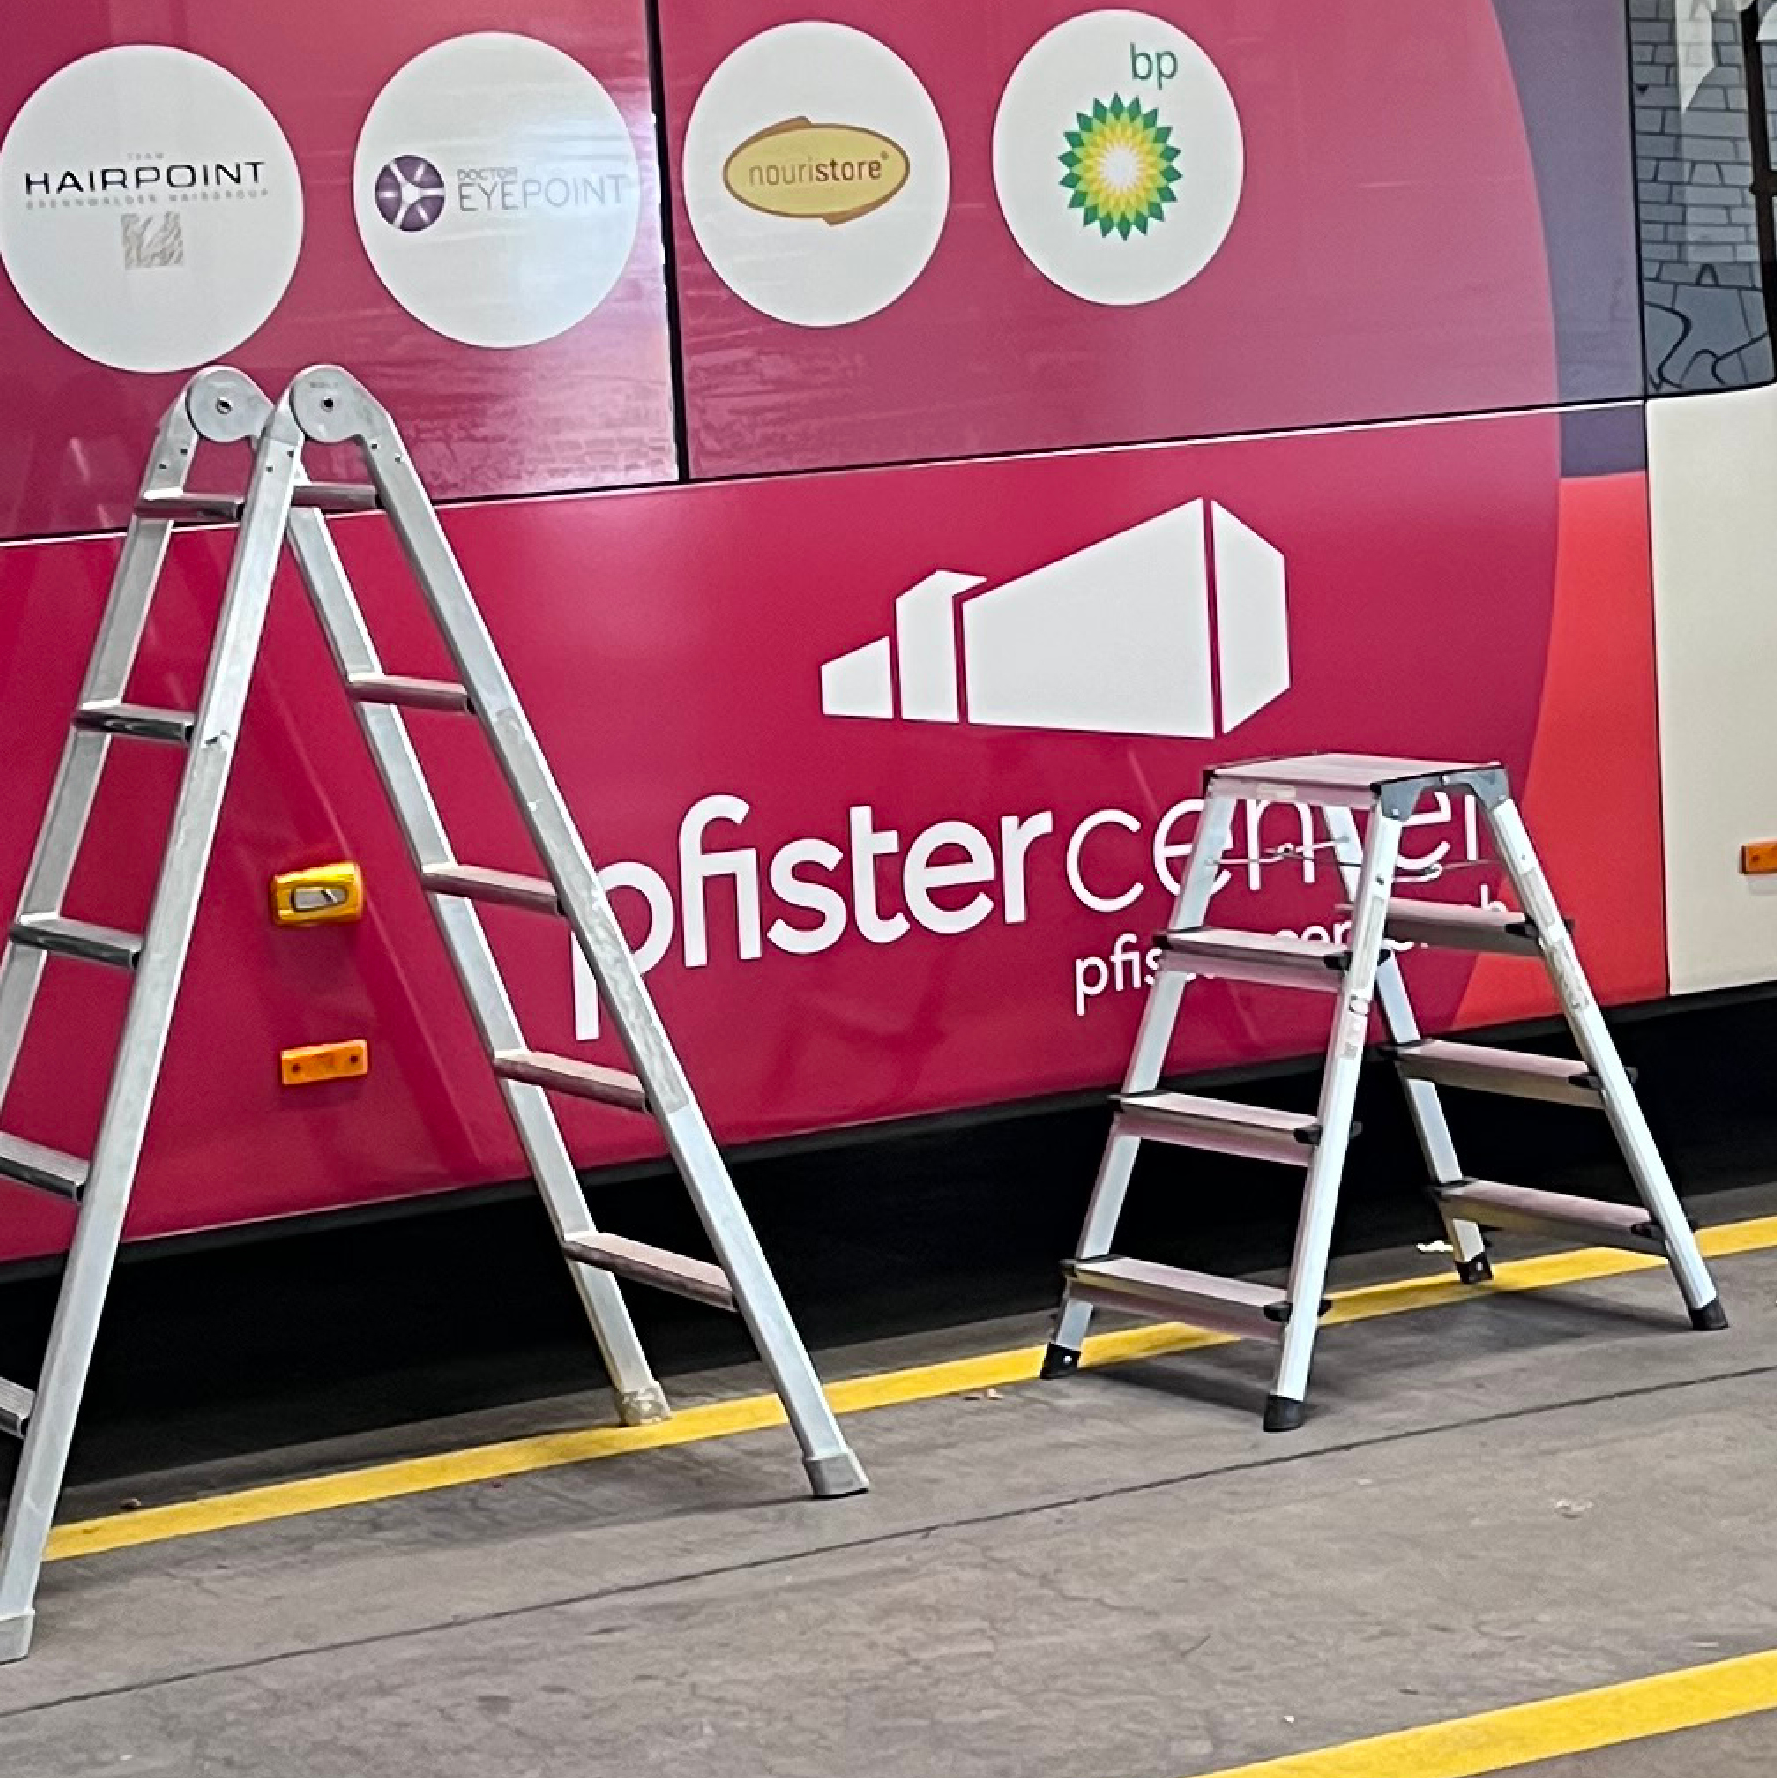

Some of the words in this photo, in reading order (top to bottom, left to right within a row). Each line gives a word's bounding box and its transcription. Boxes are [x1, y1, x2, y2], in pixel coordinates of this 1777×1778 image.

[1129, 41, 1179, 91] bp
[25, 161, 266, 196] HAIRPOINT
[457, 166, 518, 182] DOCTOR
[458, 173, 629, 212] EYEPOINT
